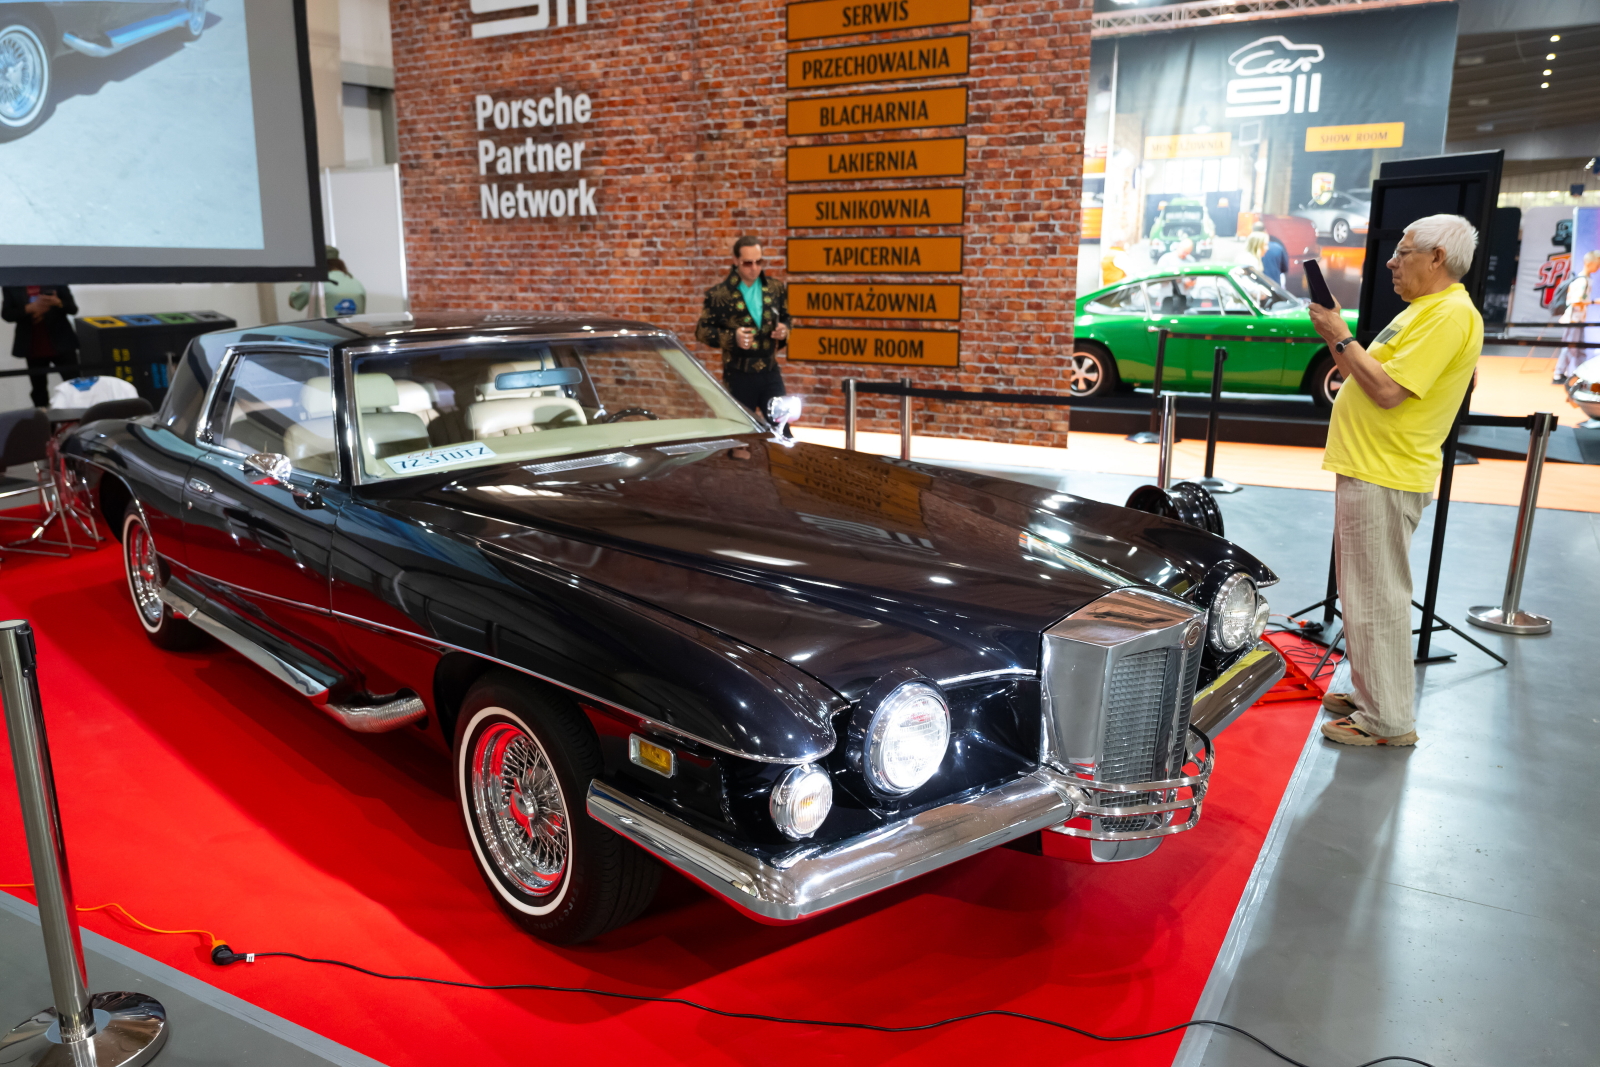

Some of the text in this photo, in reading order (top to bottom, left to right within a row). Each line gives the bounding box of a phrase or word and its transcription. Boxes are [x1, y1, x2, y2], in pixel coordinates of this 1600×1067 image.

[842, 0, 909, 28] SERWIS
[802, 47, 950, 80] PRZECHOWALNIA
[475, 87, 592, 131] Porsche
[820, 99, 929, 127] BLACHARNIA
[1320, 130, 1389, 145] SHOW ROOM
[478, 137, 586, 176] Partner
[828, 150, 918, 174] LAKIERNIA
[480, 178, 598, 220] Network
[815, 198, 931, 221] SILNIKOWNIA
[823, 246, 921, 266] TAPICERNIA
[806, 287, 937, 314] MONTAŻOWNIA
[818, 336, 924, 359] SHOW ROOM
